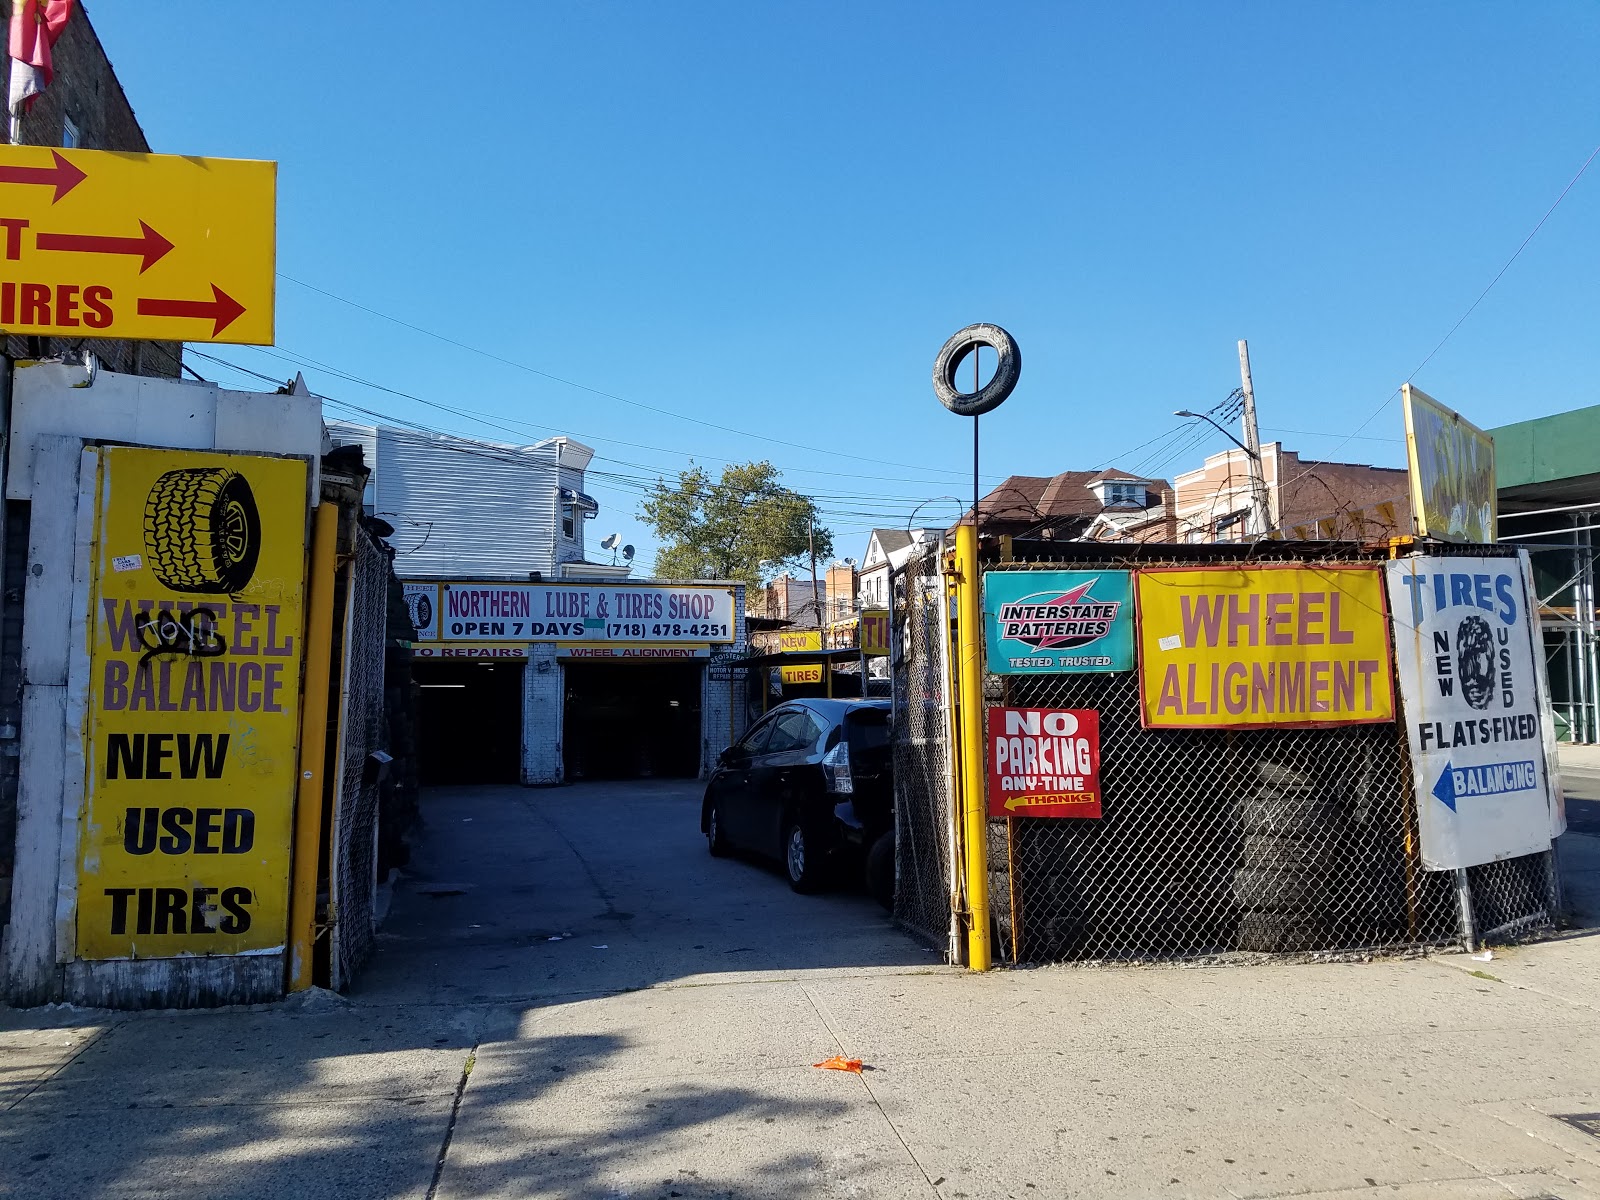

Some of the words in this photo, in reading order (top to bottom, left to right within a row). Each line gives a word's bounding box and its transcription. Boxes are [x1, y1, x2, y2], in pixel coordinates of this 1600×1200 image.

[448, 590, 530, 618] NORTHERN
[545, 591, 590, 618] LUBE
[596, 592, 609, 619] &
[615, 593, 663, 620] TIRES
[668, 594, 715, 620] SHOP
[1003, 605, 1115, 620] INTERSTATE
[1402, 573, 1517, 629] TIRES
[451, 622, 505, 636] OPEN
[512, 622, 524, 636] 7
[531, 622, 585, 636] DAYS
[606, 623, 646, 638] (718)
[652, 623, 727, 637] 478-4251
[1006, 621, 1107, 636] BATTERIES
[1180, 592, 1354, 648] WHEEL
[441, 648, 523, 657] REPAIRS
[570, 648, 618, 657] WHEEL
[622, 648, 697, 657] ALIGNMENT
[781, 637, 808, 648] NEW
[785, 669, 819, 682] TIRES
[1009, 657, 1055, 668] TESTED.
[1059, 656, 1114, 667] TRUSTED.
[1433, 630, 1453, 697] NEW
[1497, 627, 1515, 709] USED
[103, 659, 283, 713] BALANCE
[1157, 659, 1379, 716] ALIGNMENT
[1005, 710, 1079, 736] NO
[106, 733, 230, 779] NEW
[996, 737, 1091, 775] PARKING
[1001, 776, 1085, 791] ANY-TIME
[1454, 762, 1535, 795] BALANCING
[1024, 793, 1092, 805] THANKS
[123, 807, 255, 855] USED
[103, 886, 253, 935] TIRES
